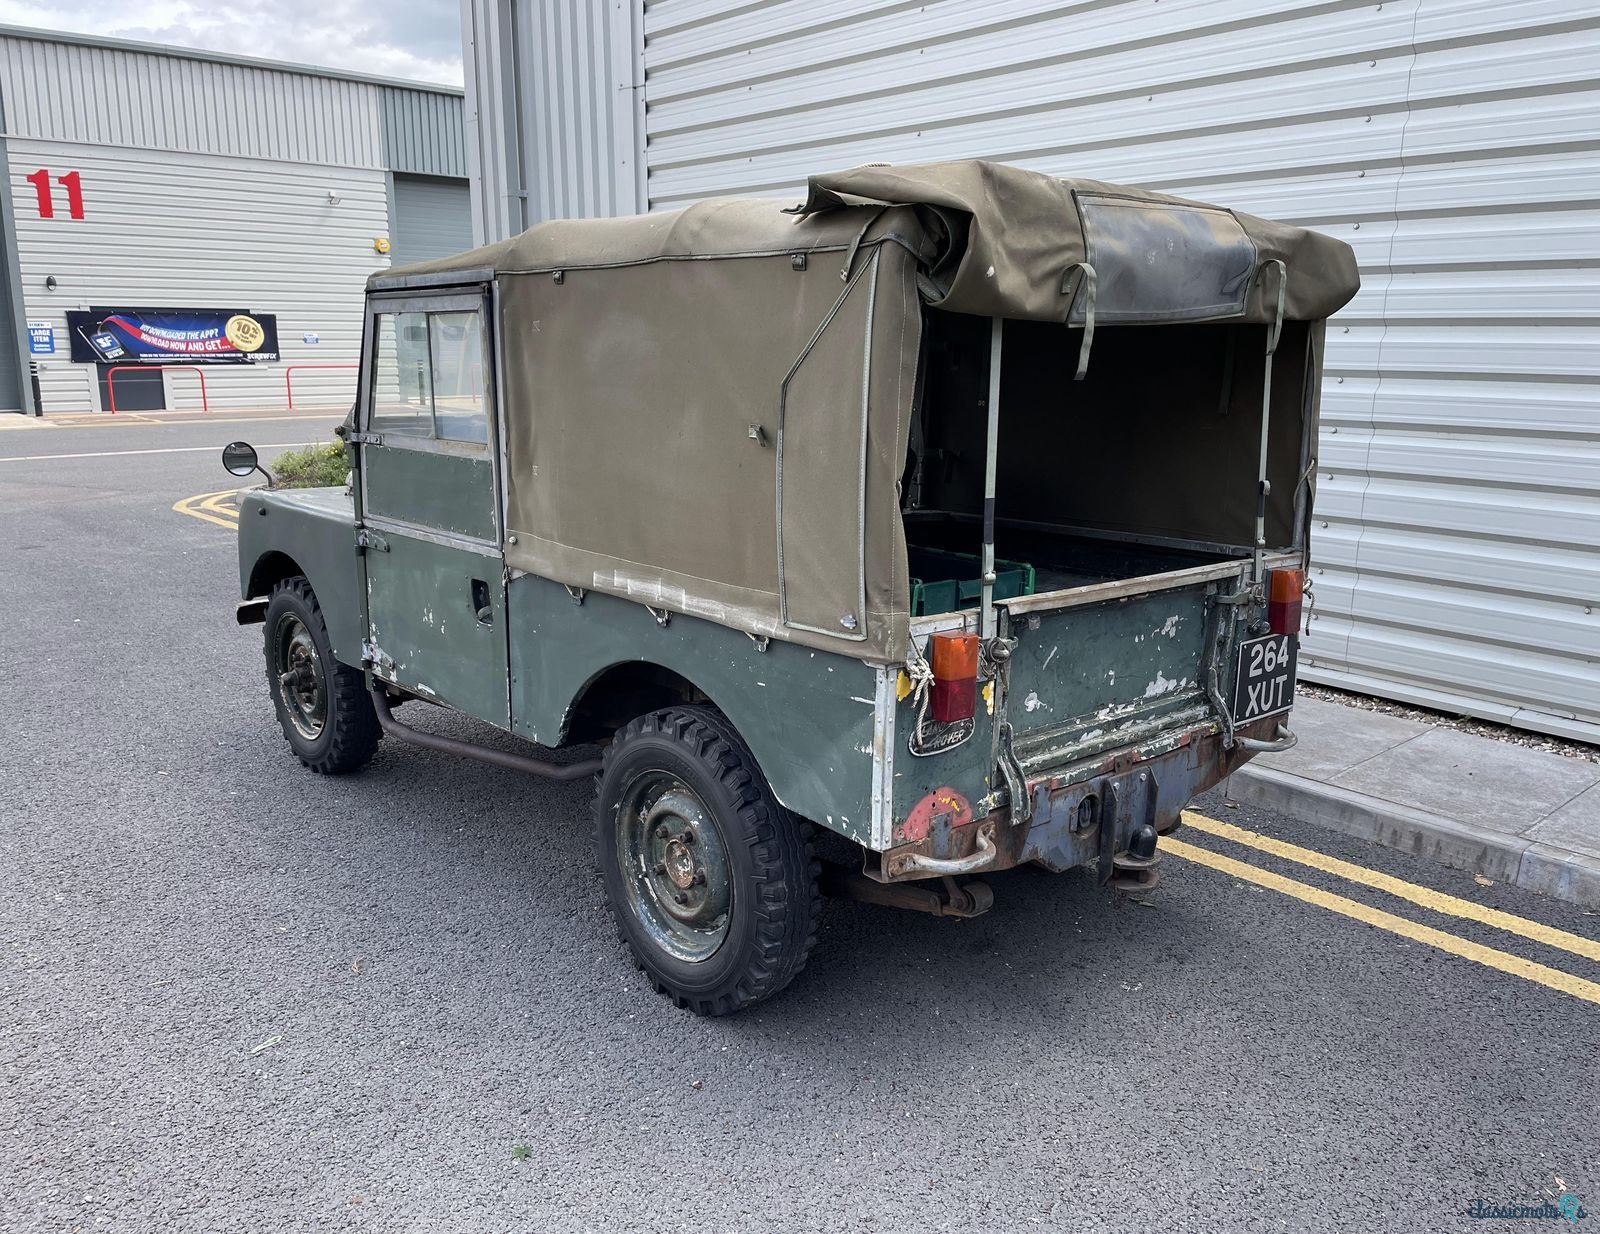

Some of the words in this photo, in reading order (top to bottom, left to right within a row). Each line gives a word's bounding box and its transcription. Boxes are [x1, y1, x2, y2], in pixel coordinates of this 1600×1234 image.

[26, 168, 85, 220] 11
[96, 335, 112, 348] SF
[140, 332, 170, 348] DOWNLOAD
[169, 341, 187, 351] NOW
[187, 341, 205, 351] AND
[205, 339, 231, 351] GET...
[149, 326, 186, 340] DOWNLOADED
[186, 330, 200, 340] THE
[199, 328, 219, 340] APP?
[1248, 635, 1289, 678] 264
[1245, 673, 1288, 717] XUT
[933, 729, 965, 749] ROVER
